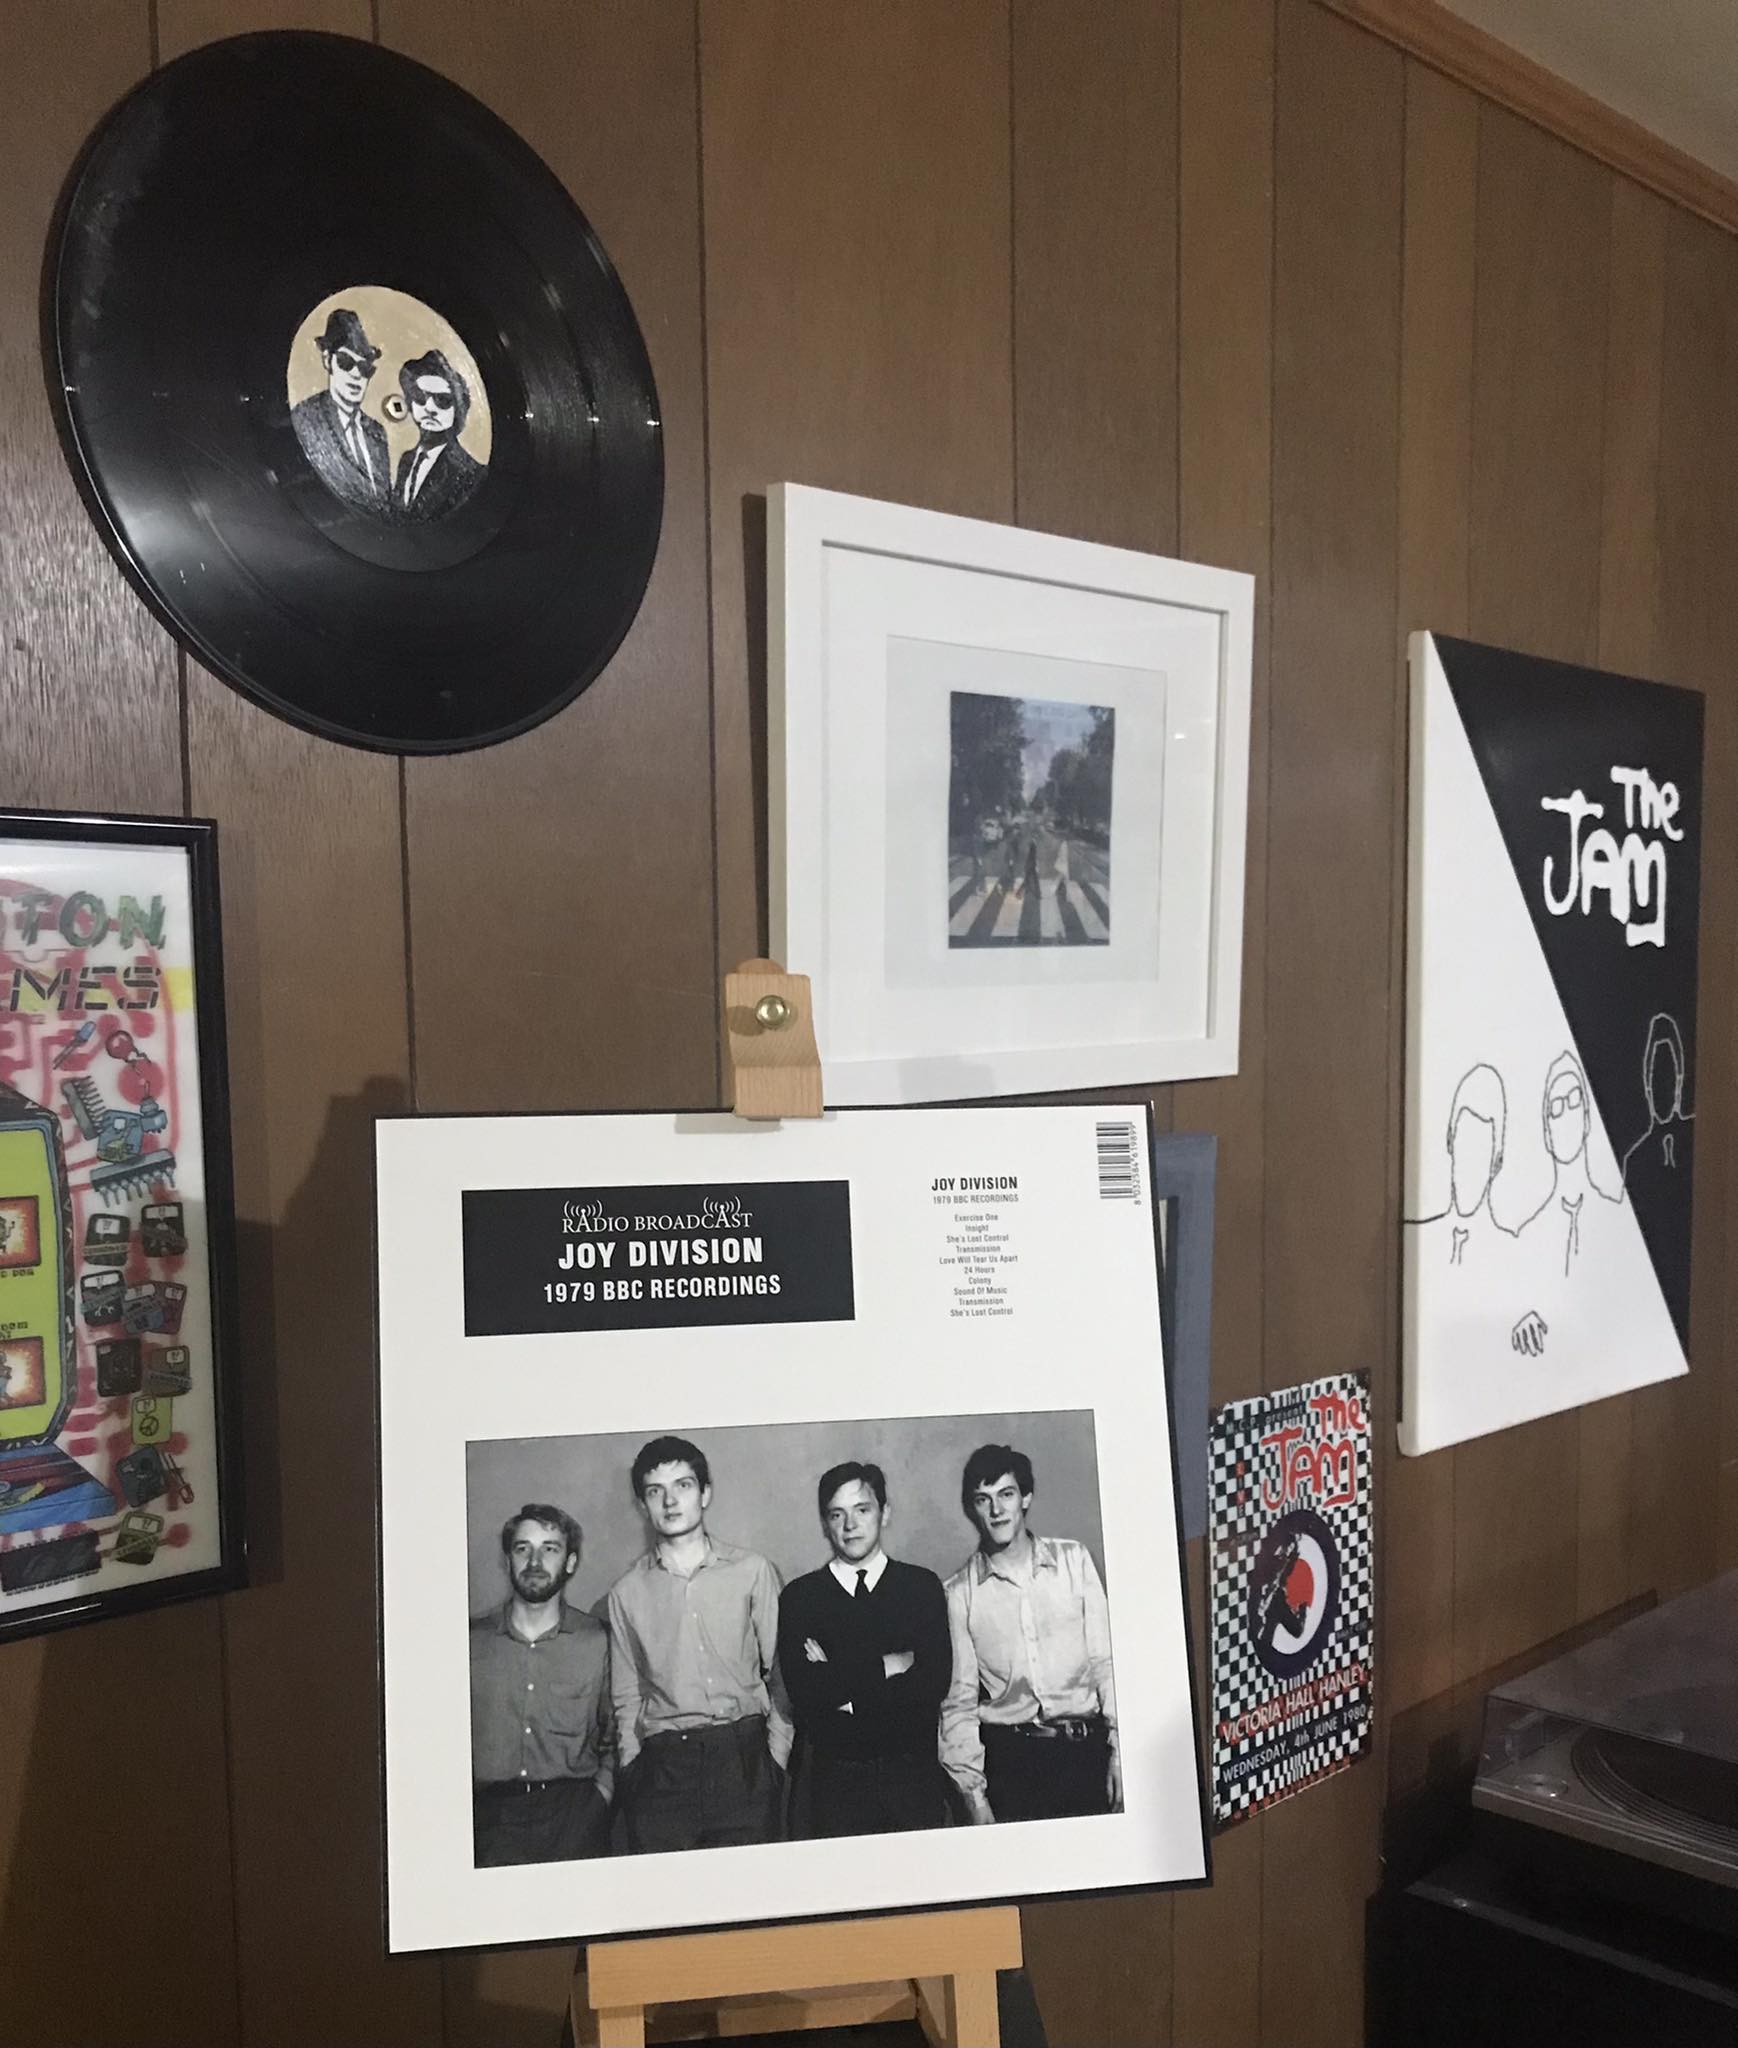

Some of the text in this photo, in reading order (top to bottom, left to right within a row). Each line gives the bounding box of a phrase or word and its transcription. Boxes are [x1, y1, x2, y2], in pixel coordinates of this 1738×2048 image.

[1610, 765, 1684, 841] The
[1541, 789, 1667, 948] JAM
[931, 1176, 1018, 1191] JOY DIVISION
[933, 1193, 1019, 1205] 1979 BBC RECORDINGS
[562, 1205, 753, 1234] RADIO BROADCAST
[954, 1213, 999, 1222] Exercise One
[965, 1223, 989, 1233] Insight
[967, 1234, 982, 1242] Lost
[984, 1233, 1009, 1242] Control
[558, 1237, 763, 1270] JOY DIVISION
[956, 1245, 1001, 1253] Transmission
[939, 1254, 1018, 1265] Love Will Tear Us Apart
[964, 1266, 995, 1274] 24 Hours
[968, 1276, 992, 1286] Colony
[544, 1274, 782, 1303] 1979 BBC RECORDINGS
[954, 1287, 975, 1296] Sound
[986, 1286, 1007, 1294] Music
[959, 1297, 1004, 1306] Transmission
[971, 1308, 986, 1316] Lost
[988, 1307, 1013, 1316] Control
[1309, 1391, 1365, 1436] The
[1261, 1426, 1357, 1511] JAM
[1222, 1663, 1367, 1744] VICTORIA HALL HANLEY
[1294, 1730, 1310, 1747] 4th
[1313, 1716, 1338, 1739] JUNE
[1342, 1703, 1367, 1726] 1980
